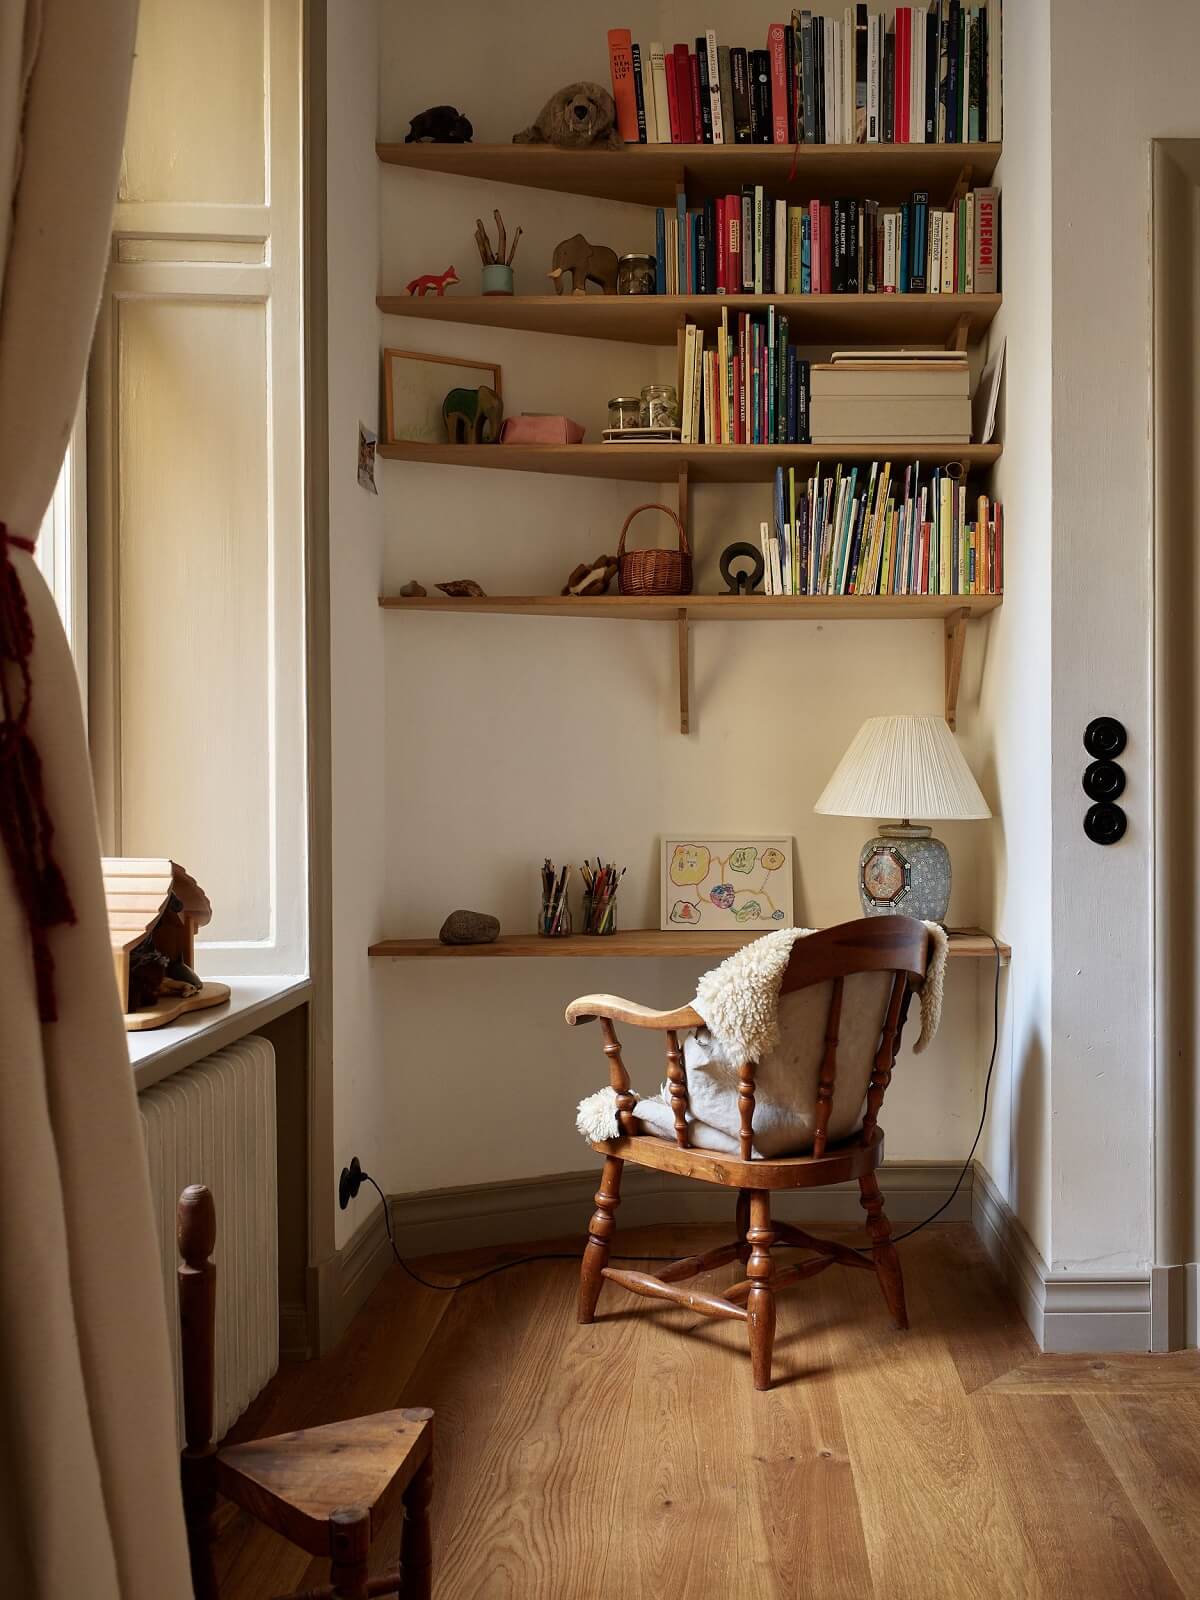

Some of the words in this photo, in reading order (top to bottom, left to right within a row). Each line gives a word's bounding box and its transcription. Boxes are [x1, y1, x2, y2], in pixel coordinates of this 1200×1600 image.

[632, 50, 641, 72] PETRA
[916, 194, 925, 202] PS
[980, 202, 993, 265] SIMENON
